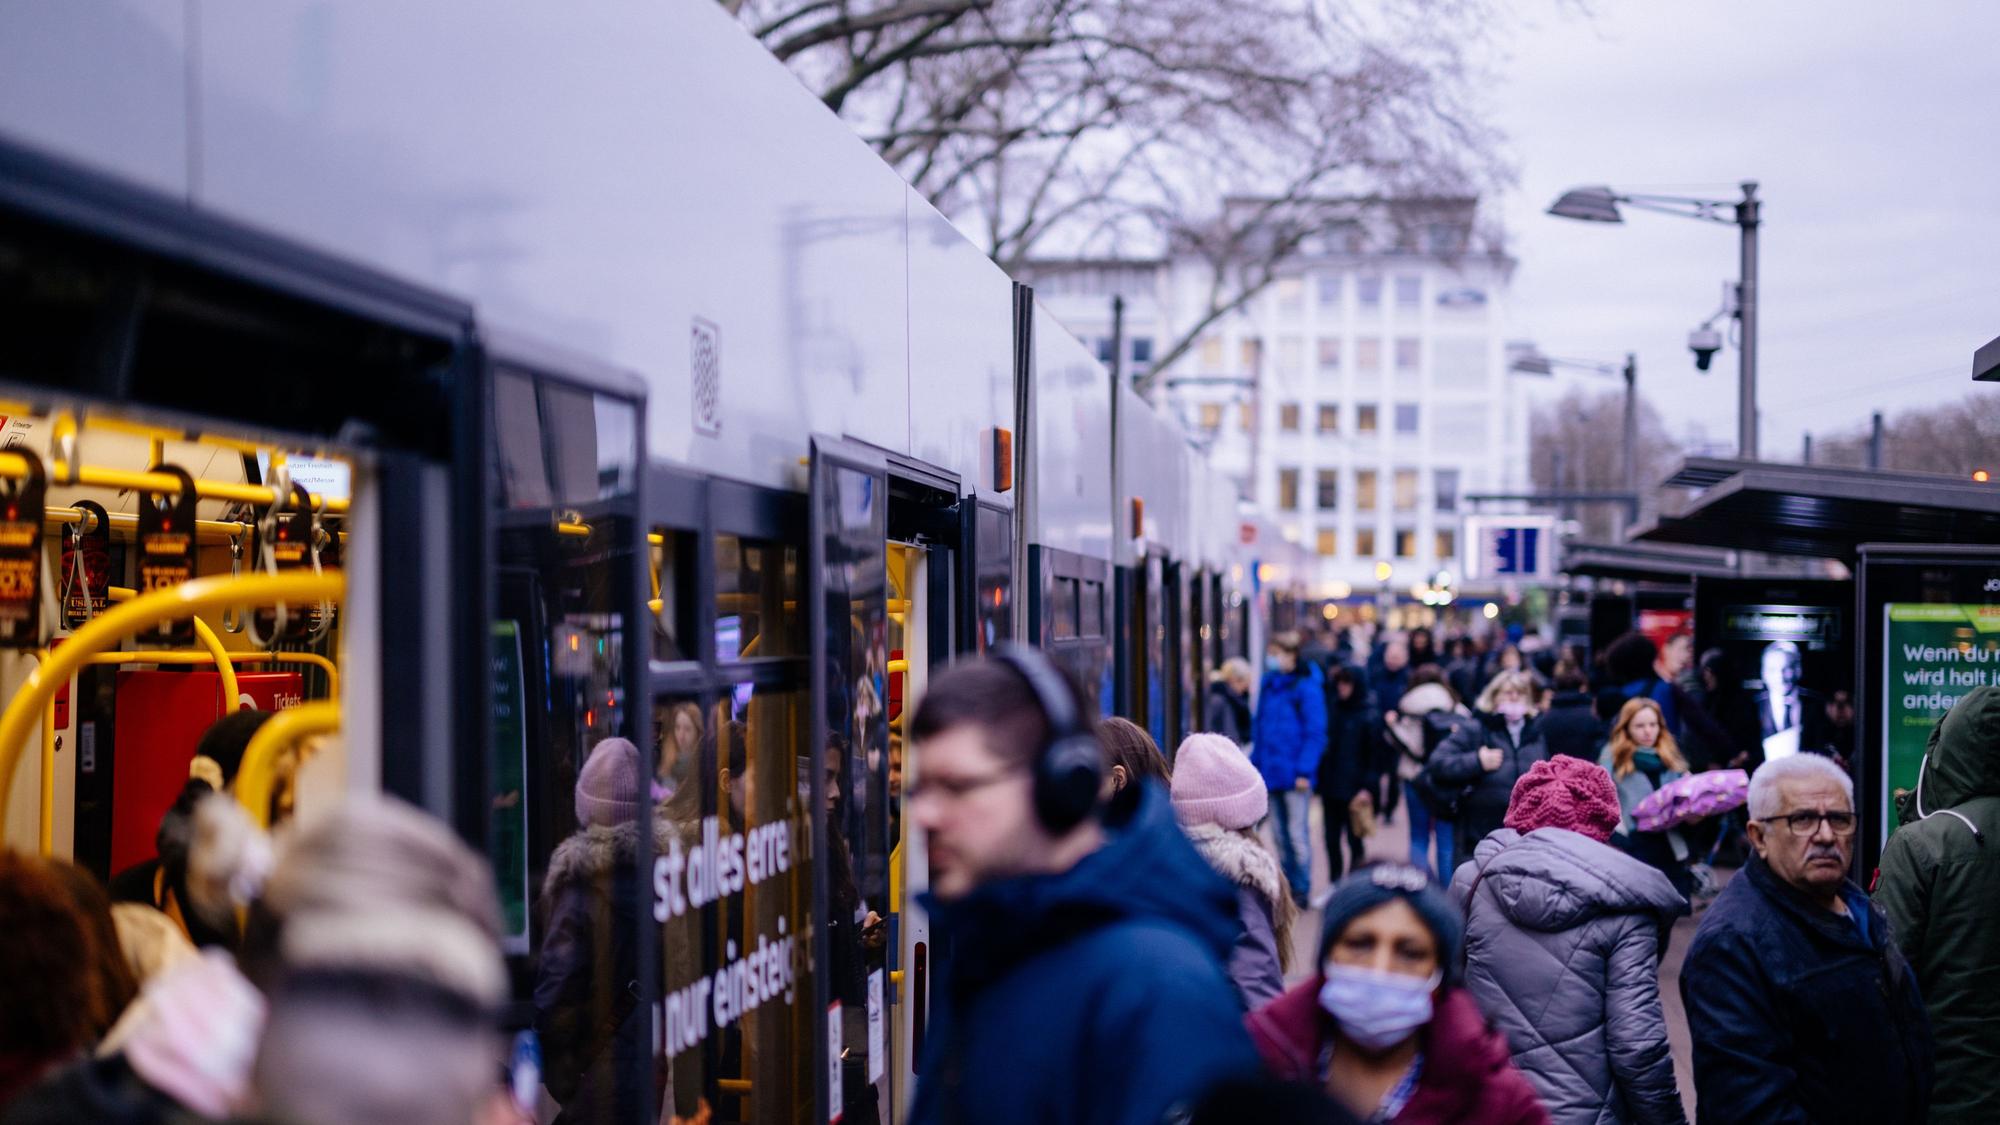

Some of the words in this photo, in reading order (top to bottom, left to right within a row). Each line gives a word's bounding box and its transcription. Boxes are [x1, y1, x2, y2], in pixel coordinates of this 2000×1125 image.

[1903, 643, 1959, 662] Wenn
[1963, 643, 1989, 662] du
[1903, 667, 1945, 686] wird
[1949, 667, 1986, 686] halt
[273, 692, 301, 710] Tickets
[687, 815, 745, 909] alles
[665, 975, 712, 1057] nur
